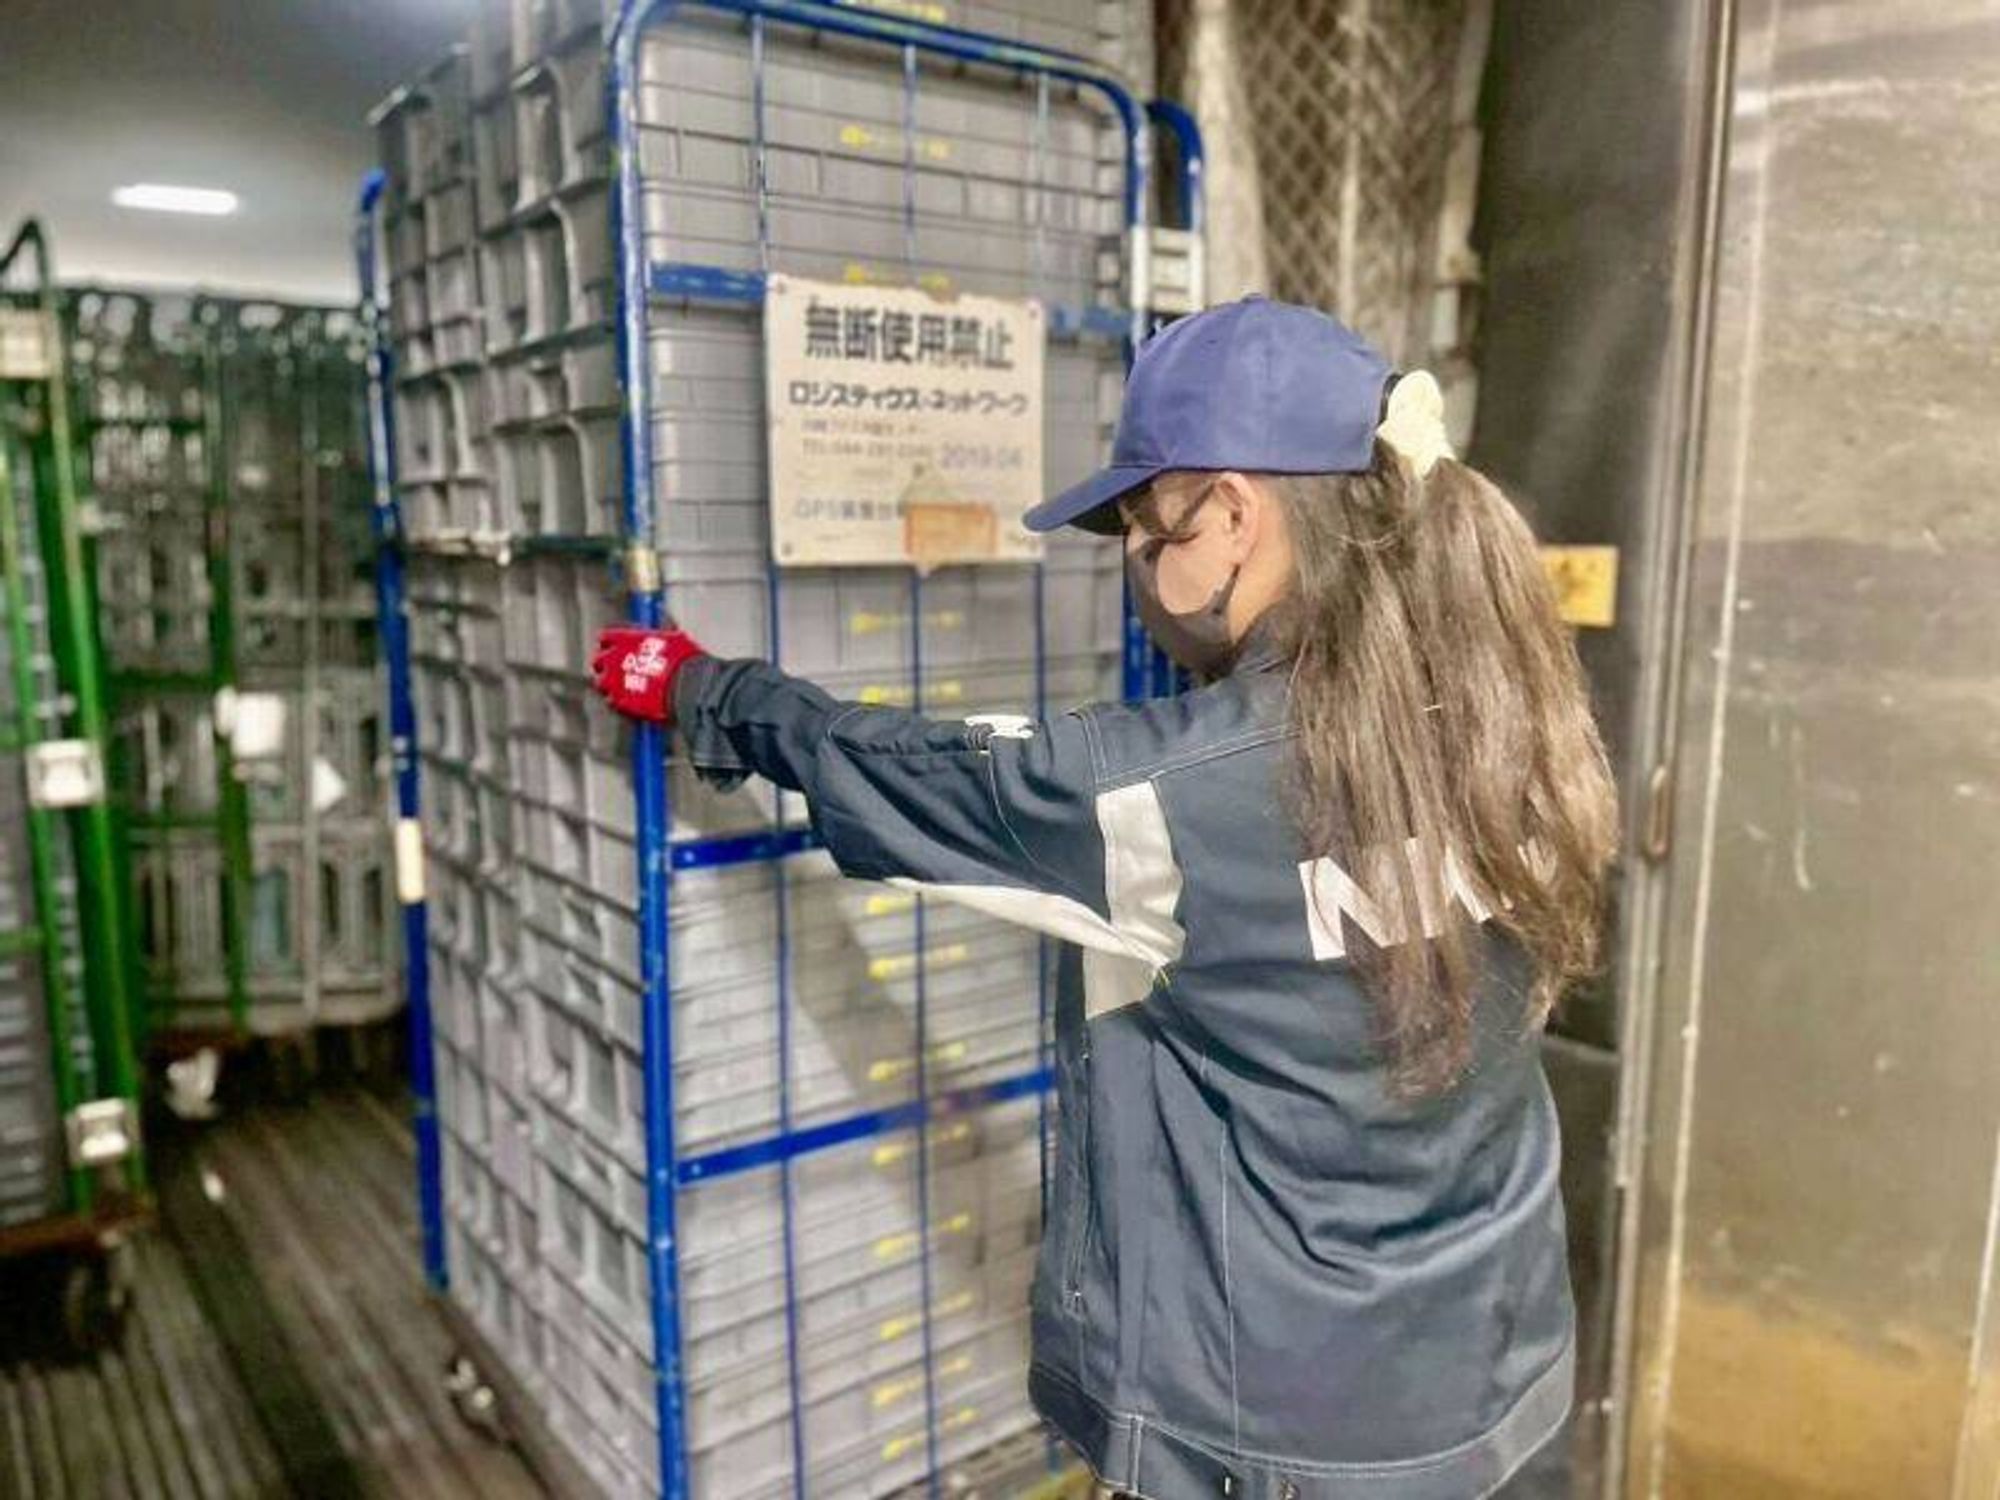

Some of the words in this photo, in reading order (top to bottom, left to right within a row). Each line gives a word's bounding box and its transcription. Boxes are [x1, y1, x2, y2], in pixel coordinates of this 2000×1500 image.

[805, 297, 1015, 370] 無断使用禁止
